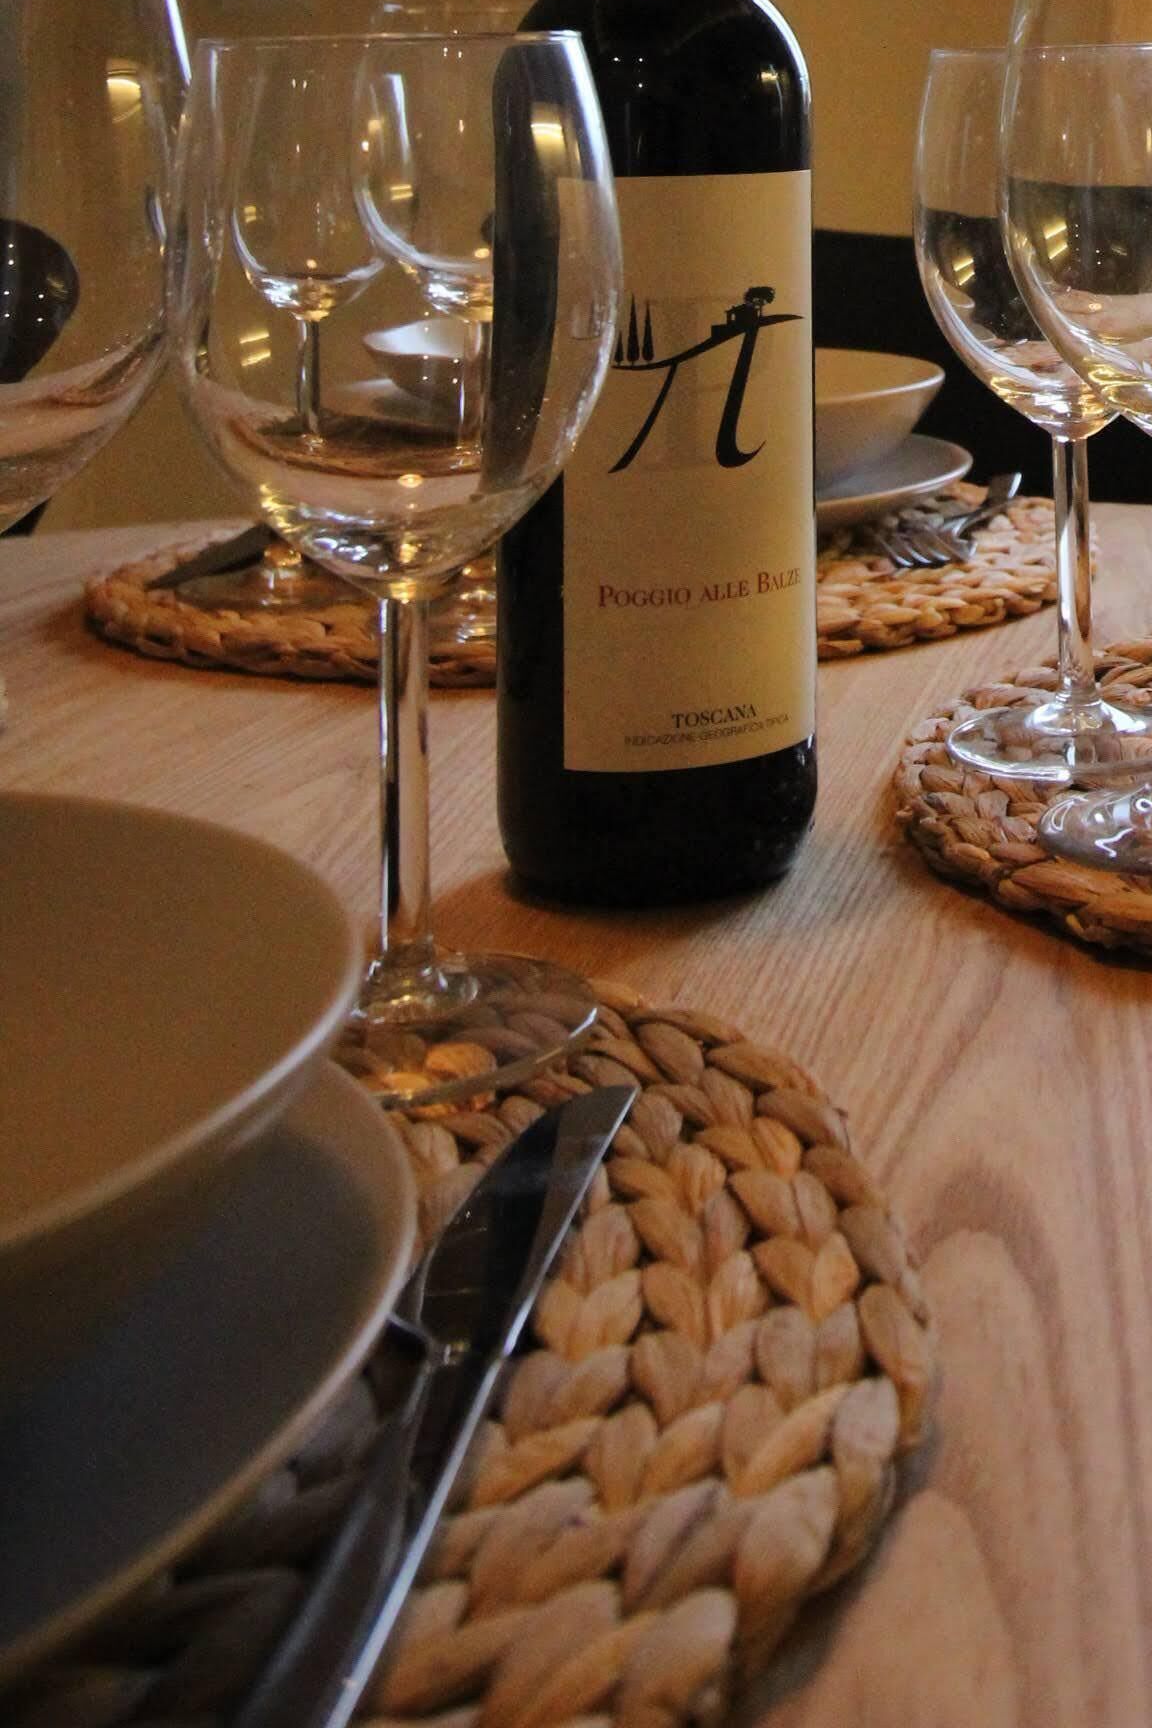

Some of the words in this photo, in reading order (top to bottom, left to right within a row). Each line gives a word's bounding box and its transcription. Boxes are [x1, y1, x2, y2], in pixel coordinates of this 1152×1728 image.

[598, 584, 691, 608] POGGIO
[700, 579, 750, 602] ALLE
[671, 703, 757, 729] TOSCANA
